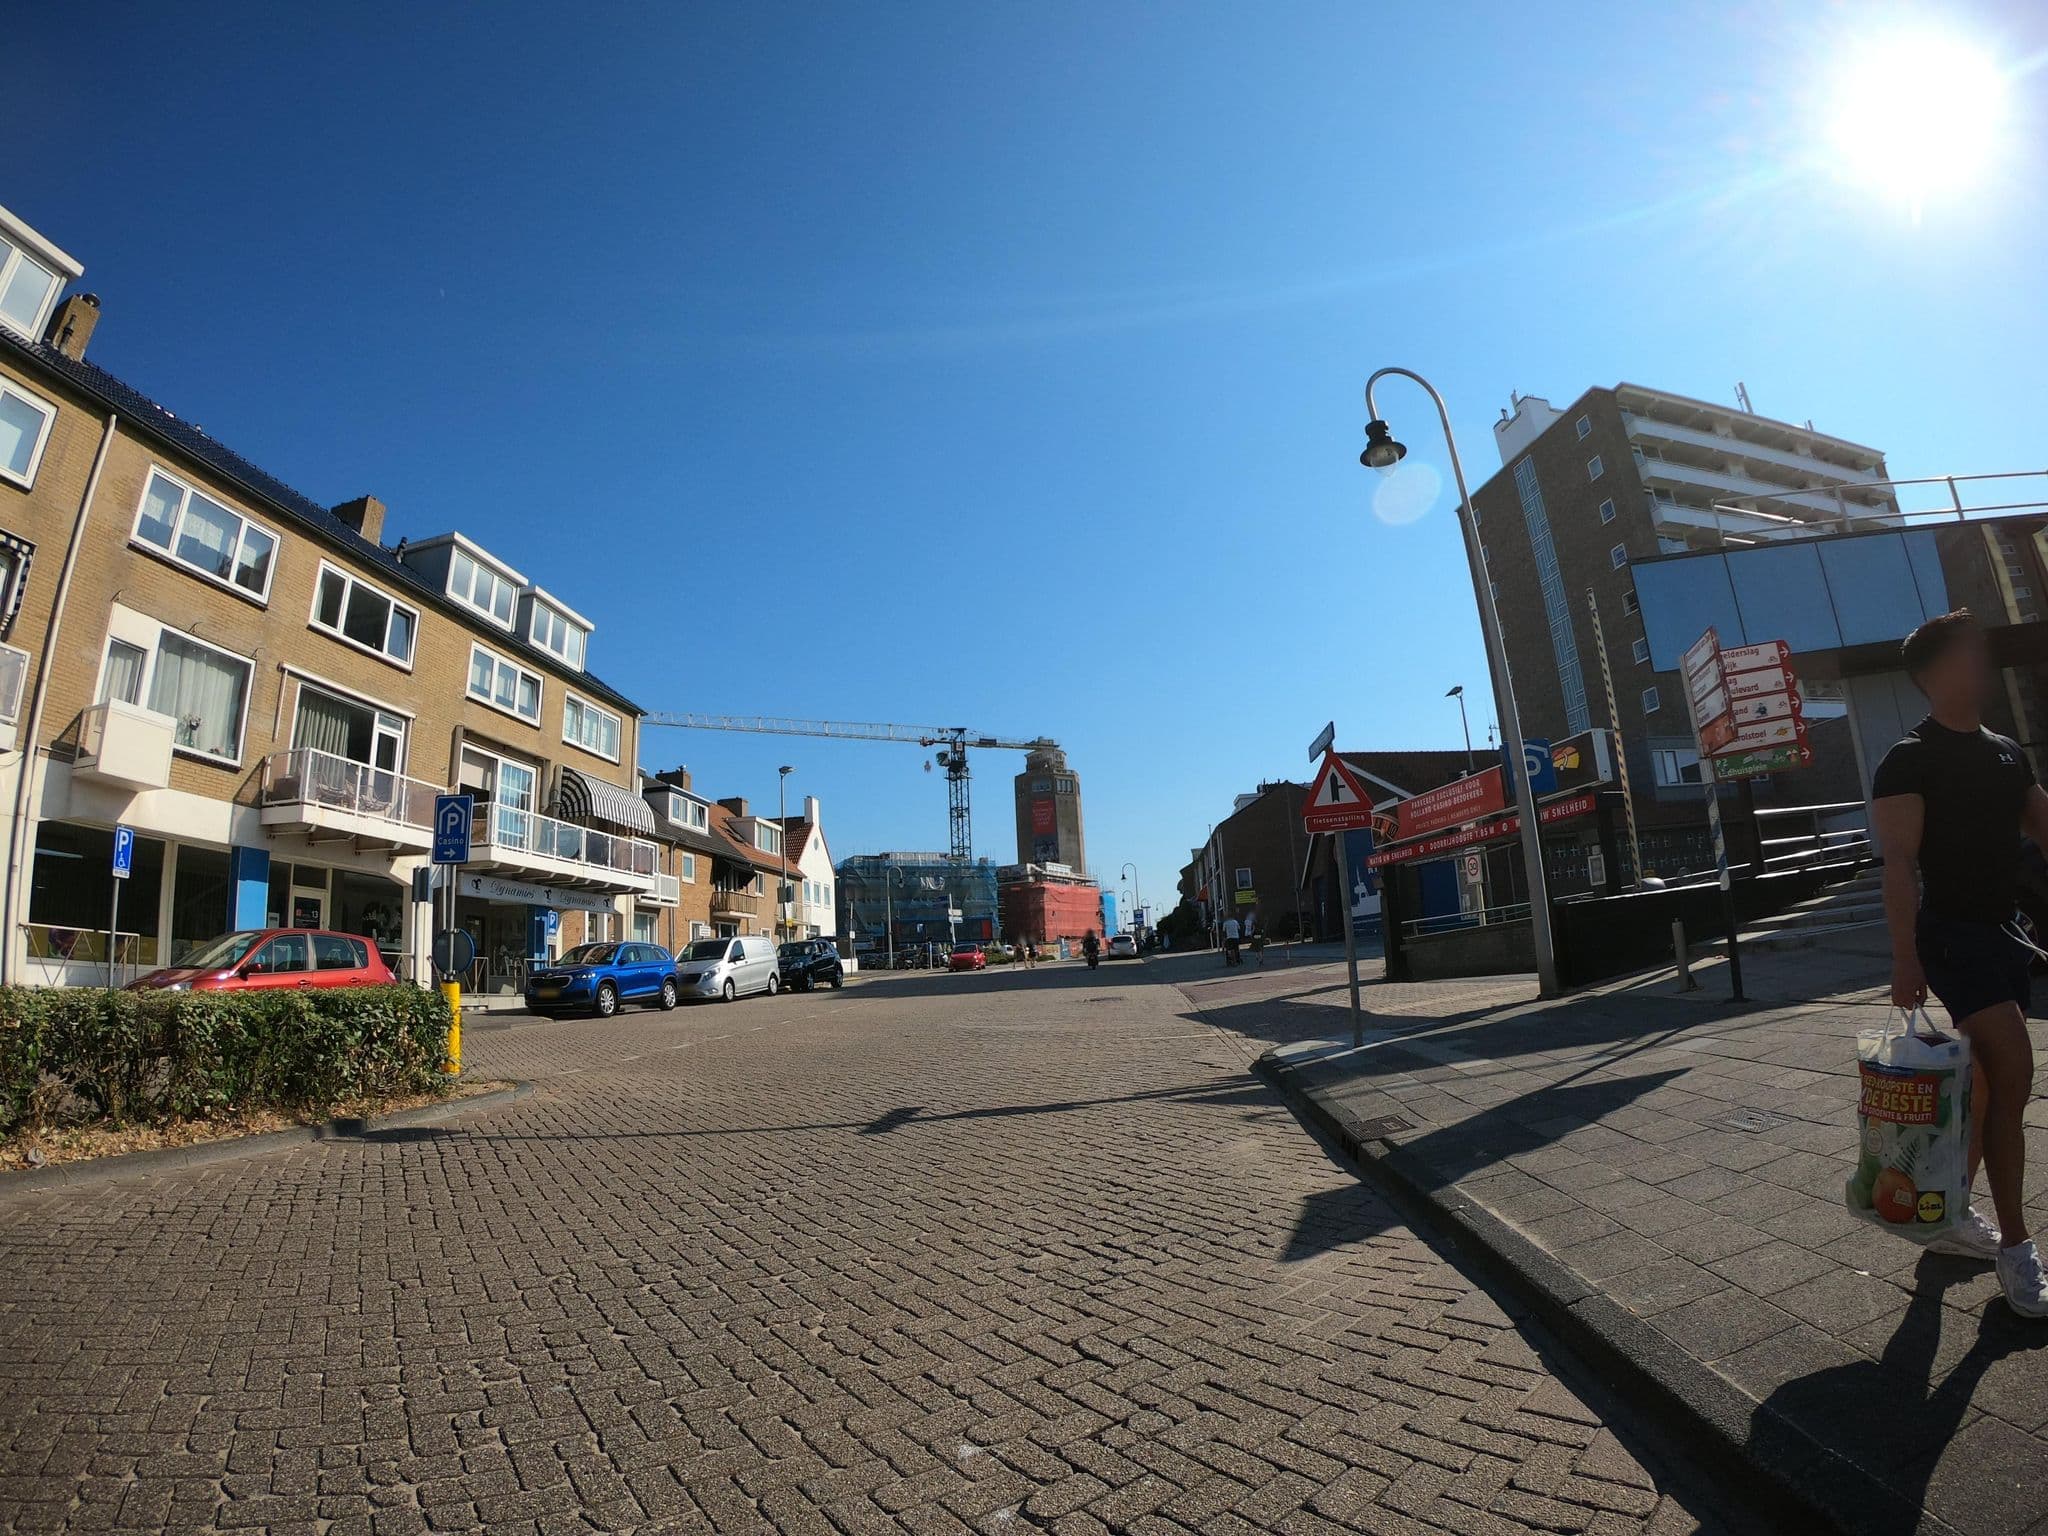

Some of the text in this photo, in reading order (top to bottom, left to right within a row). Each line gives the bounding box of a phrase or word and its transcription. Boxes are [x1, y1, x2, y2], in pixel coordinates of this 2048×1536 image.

[1552, 799, 1587, 817] SNELHEID
[447, 812, 459, 834] P
[118, 831, 129, 852] P
[438, 837, 464, 845] Casino
[1917, 1083, 1933, 1095] EN
[1865, 1088, 1932, 1112] DE BESTE
